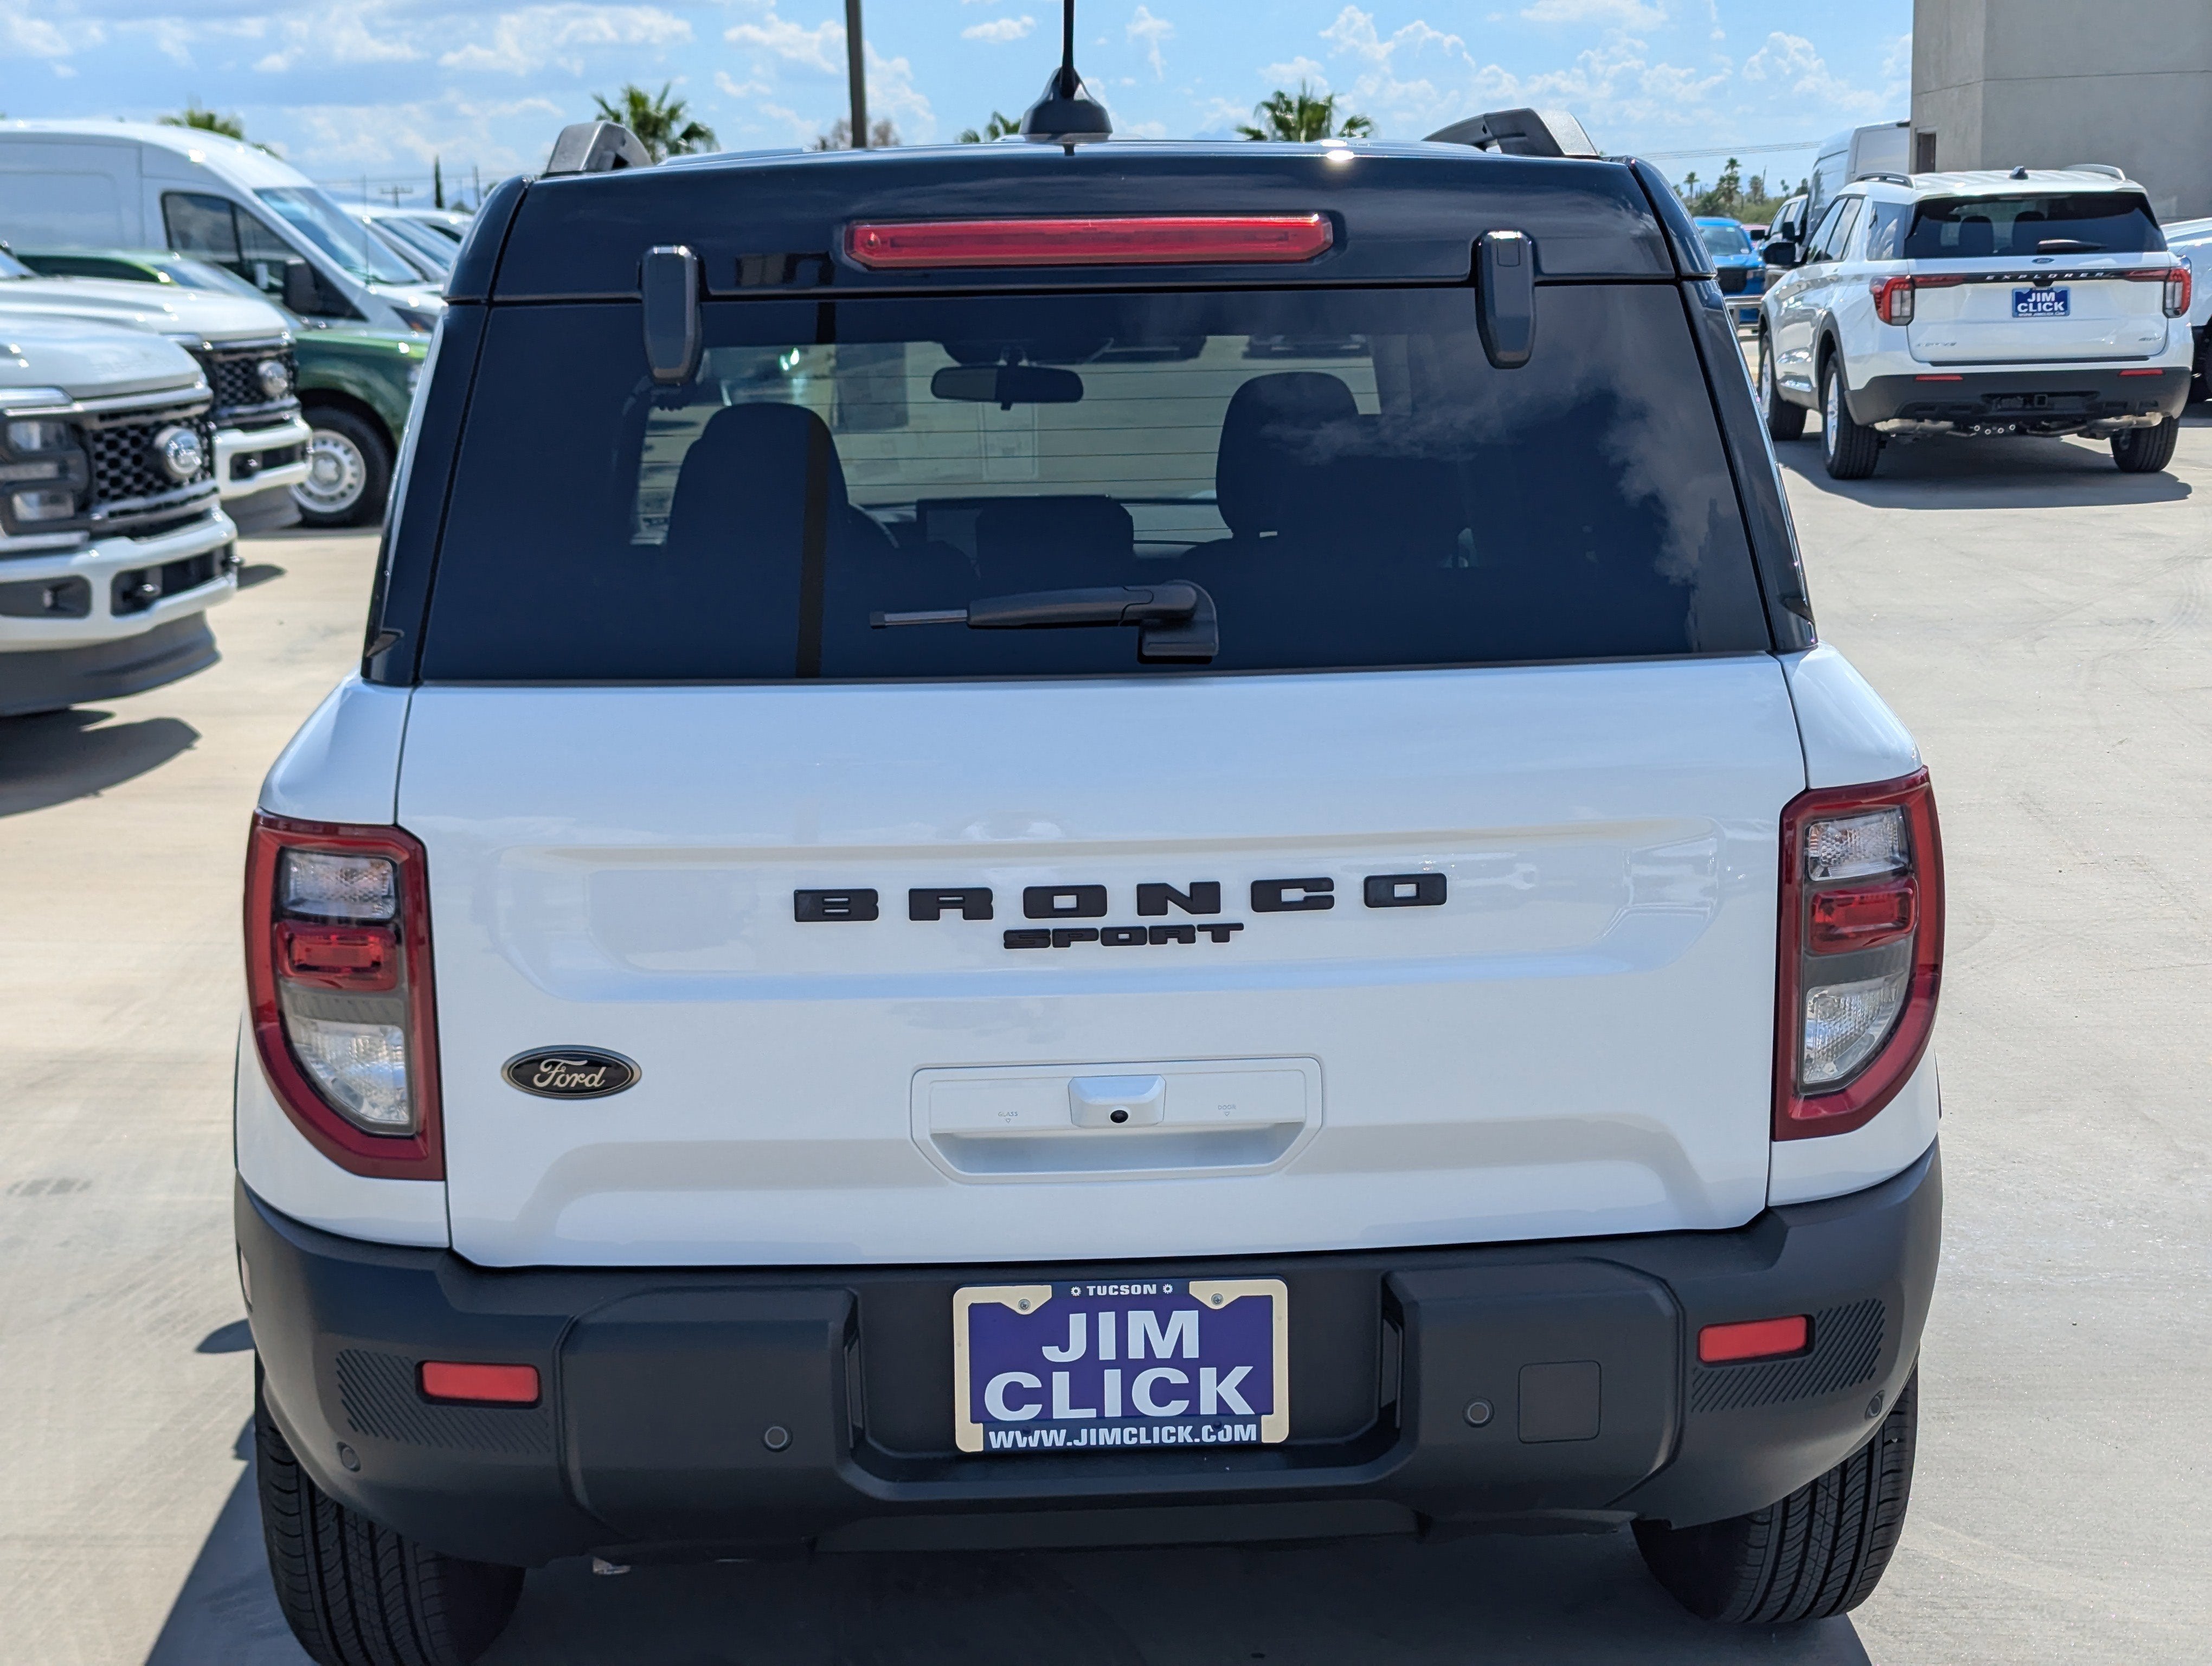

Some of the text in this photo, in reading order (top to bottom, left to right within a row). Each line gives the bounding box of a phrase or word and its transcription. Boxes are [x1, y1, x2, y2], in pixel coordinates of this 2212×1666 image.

[2017, 302, 2065, 312] CLICK
[2027, 292, 2055, 302] JIM
[793, 873, 1447, 922] BRONCO
[1004, 922, 1244, 949] SPORT
[533, 1058, 607, 1087] Ford
[1086, 1284, 1157, 1296] TUCSON
[1041, 1310, 1199, 1362] JIM
[984, 1366, 1256, 1421] CLICK
[988, 1424, 1257, 1449] WWW.JIMCLICK.COM
